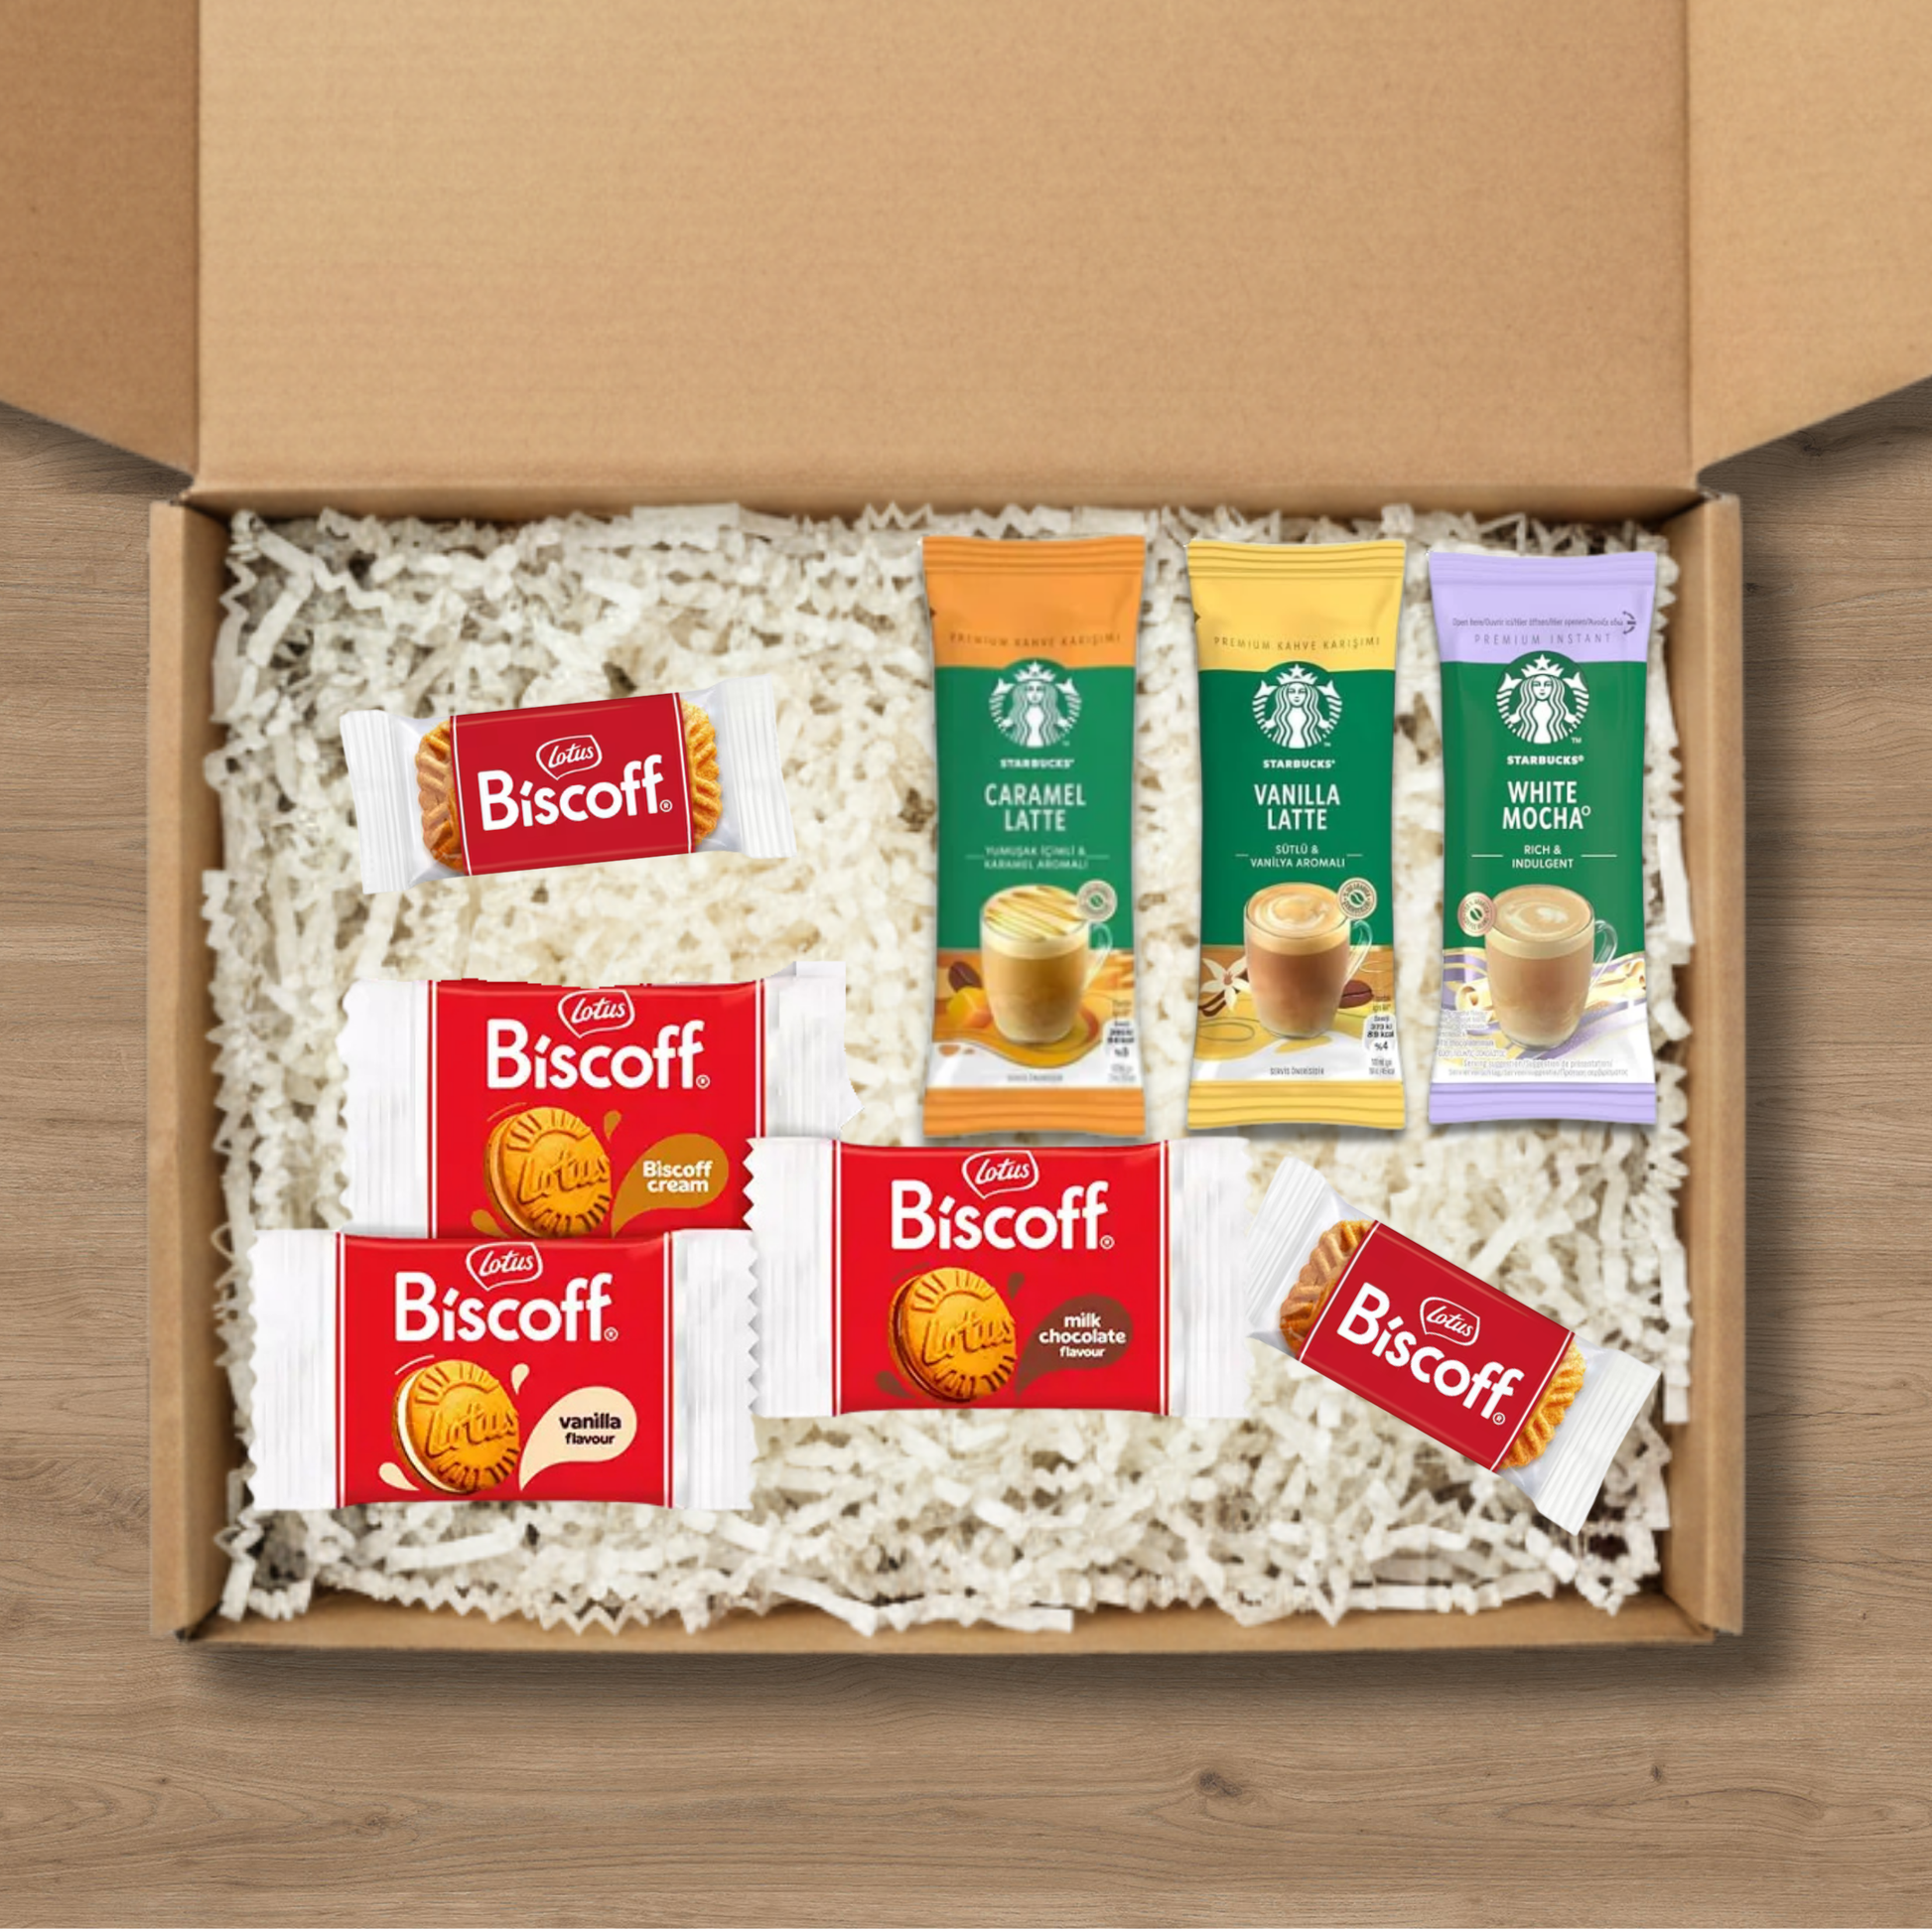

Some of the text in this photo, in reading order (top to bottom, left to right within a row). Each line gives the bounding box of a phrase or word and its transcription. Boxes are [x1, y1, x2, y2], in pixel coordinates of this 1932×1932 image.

[1214, 636, 1271, 650] PREMIUM
[1278, 641, 1316, 651] KAHVE
[1474, 633, 1611, 645] PREMIUM INSTANT
[548, 740, 596, 768] Lotus
[1263, 759, 1331, 768] STARBUCKS
[478, 755, 663, 832] Biscoff
[985, 783, 1086, 806] CARAMEL
[1254, 783, 1340, 805] VANILLA
[1507, 781, 1578, 803] WHITE
[1005, 809, 1066, 832] LATTE
[1268, 808, 1327, 830] LATTE
[1275, 843, 1318, 855] SÜTLÜ &
[1524, 846, 1562, 855] RICH &
[1296, 858, 1345, 868] AROMALI
[1512, 859, 1574, 869] INDULGENT
[572, 997, 626, 1025] Lotus
[487, 1019, 705, 1089] Biscoff
[643, 1161, 713, 1178] Biscoff
[975, 1159, 1030, 1185] Lotus
[647, 1178, 709, 1192] cream
[891, 1179, 1109, 1250] Biscoff
[480, 1245, 533, 1278] Lotus
[394, 1272, 613, 1341] Biscoff
[1063, 1312, 1101, 1328] milk
[1427, 1305, 1475, 1338] Lotus
[1038, 1327, 1126, 1344] chocolate
[1059, 1346, 1105, 1357] flavour
[1336, 1282, 1525, 1420] Biscoff
[559, 1412, 621, 1430] vanilla
[565, 1433, 616, 1446] flavour
